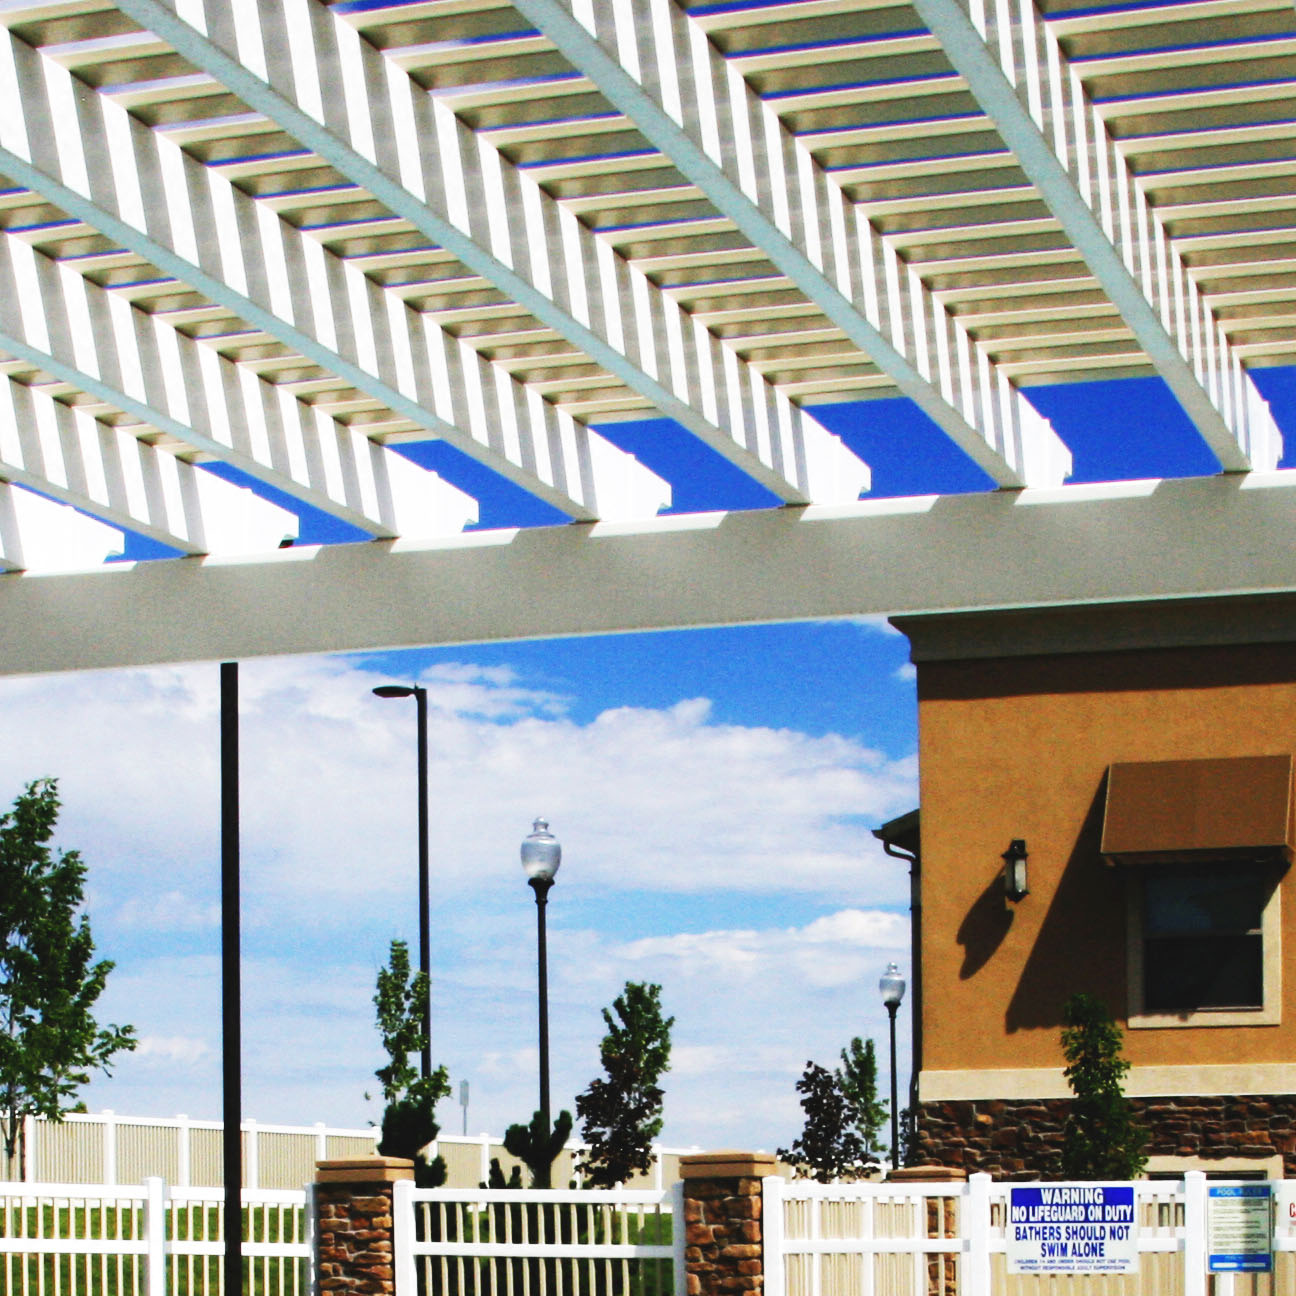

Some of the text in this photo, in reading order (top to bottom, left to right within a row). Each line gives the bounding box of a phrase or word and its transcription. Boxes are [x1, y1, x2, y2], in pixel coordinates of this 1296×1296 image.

[1041, 1188, 1104, 1204] WARNING
[1012, 1204, 1132, 1222] NO LIFEGUARD ON DUTY
[1015, 1225, 1130, 1241] BATHERS SHOULD NOT
[1041, 1242, 1105, 1257] SWIM ALONE
